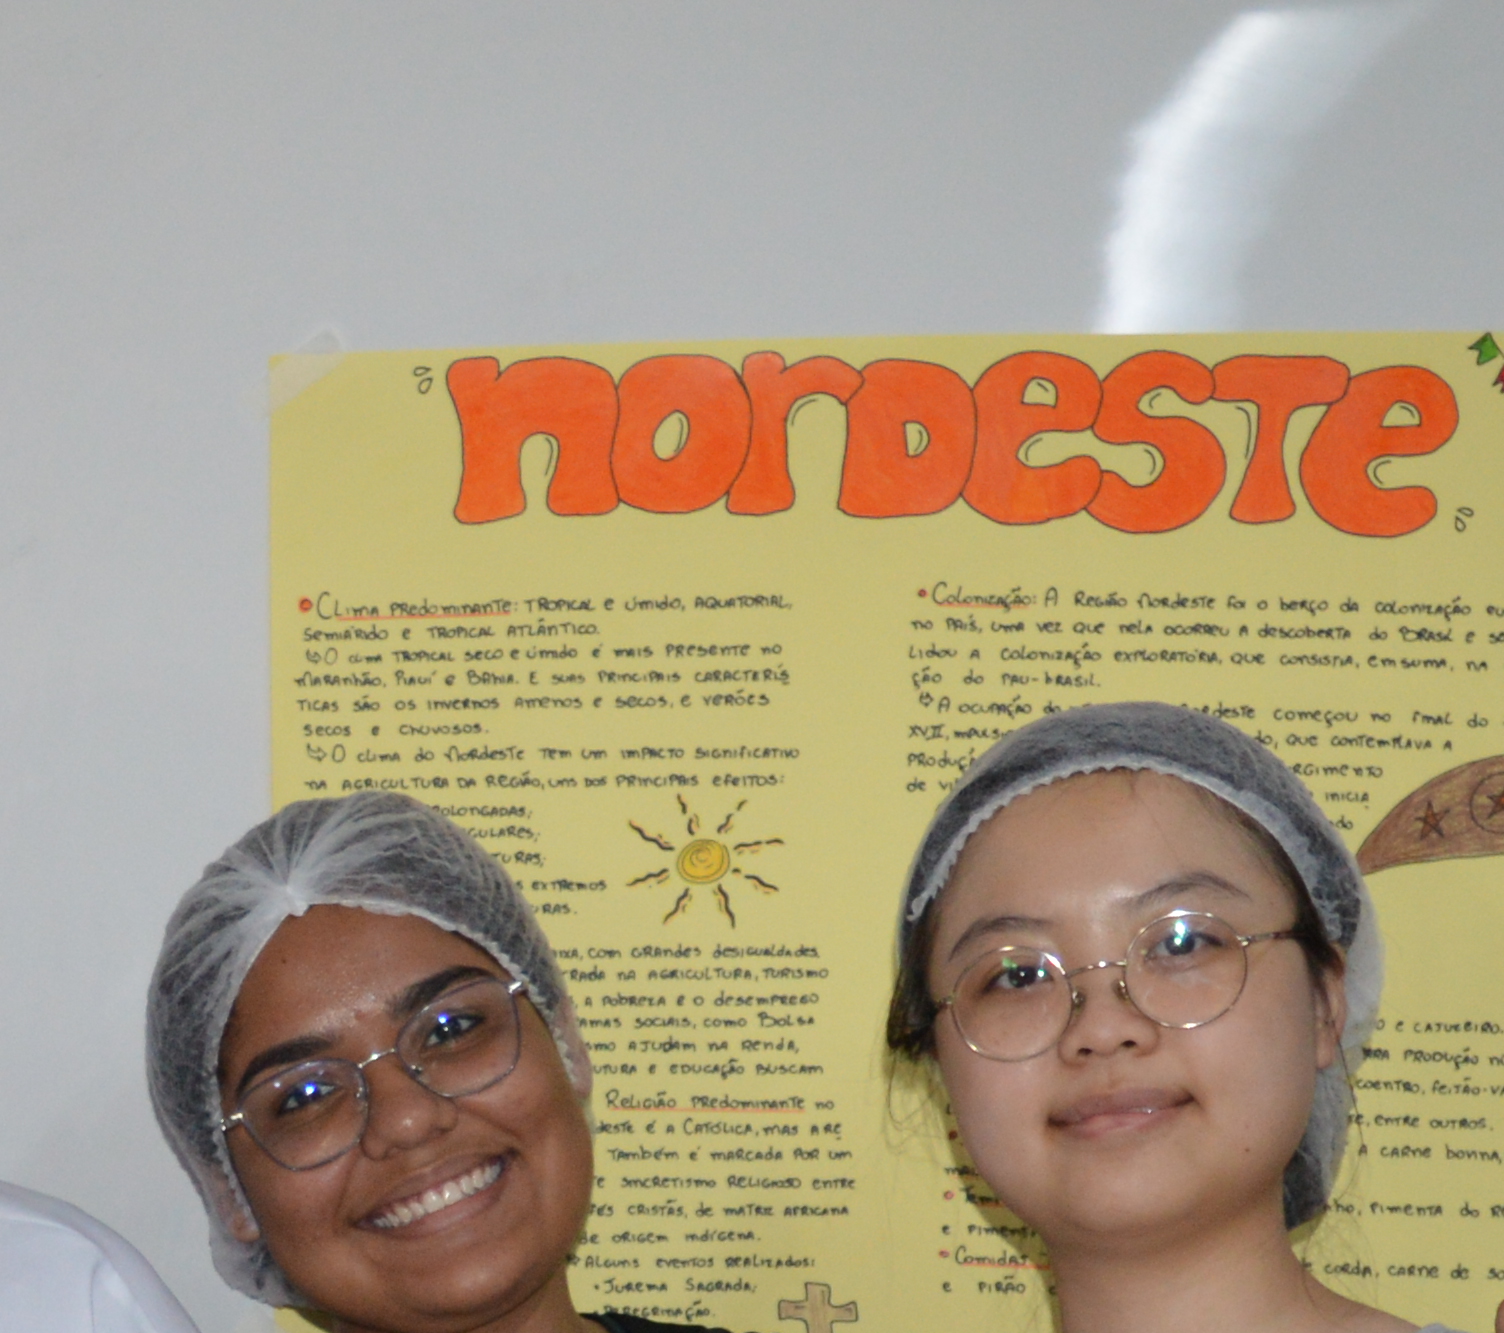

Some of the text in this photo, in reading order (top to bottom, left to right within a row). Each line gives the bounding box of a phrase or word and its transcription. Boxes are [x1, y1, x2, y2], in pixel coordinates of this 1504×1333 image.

[1043, 586, 1059, 609] A
[1226, 595, 1246, 610] foi
[1256, 599, 1268, 611] o
[911, 620, 933, 630] no
[1036, 621, 1063, 634] vez
[1368, 626, 1388, 641] do
[464, 648, 504, 662] seco
[760, 644, 782, 655] no
[963, 669, 984, 685] do
[937, 696, 951, 714] A
[1273, 708, 1358, 728] começou
[1370, 712, 1391, 723] no
[1467, 713, 1489, 728] do
[303, 724, 351, 737] secos
[414, 747, 434, 762] do
[581, 748, 607, 760] um
[588, 946, 622, 959] com
[704, 1016, 748, 1029] como
[815, 1100, 835, 1110] no
[828, 1149, 853, 1161] um
[695, 1201, 715, 1218] de
[1459, 1201, 1480, 1218] do
[1450, 1263, 1469, 1280] de
